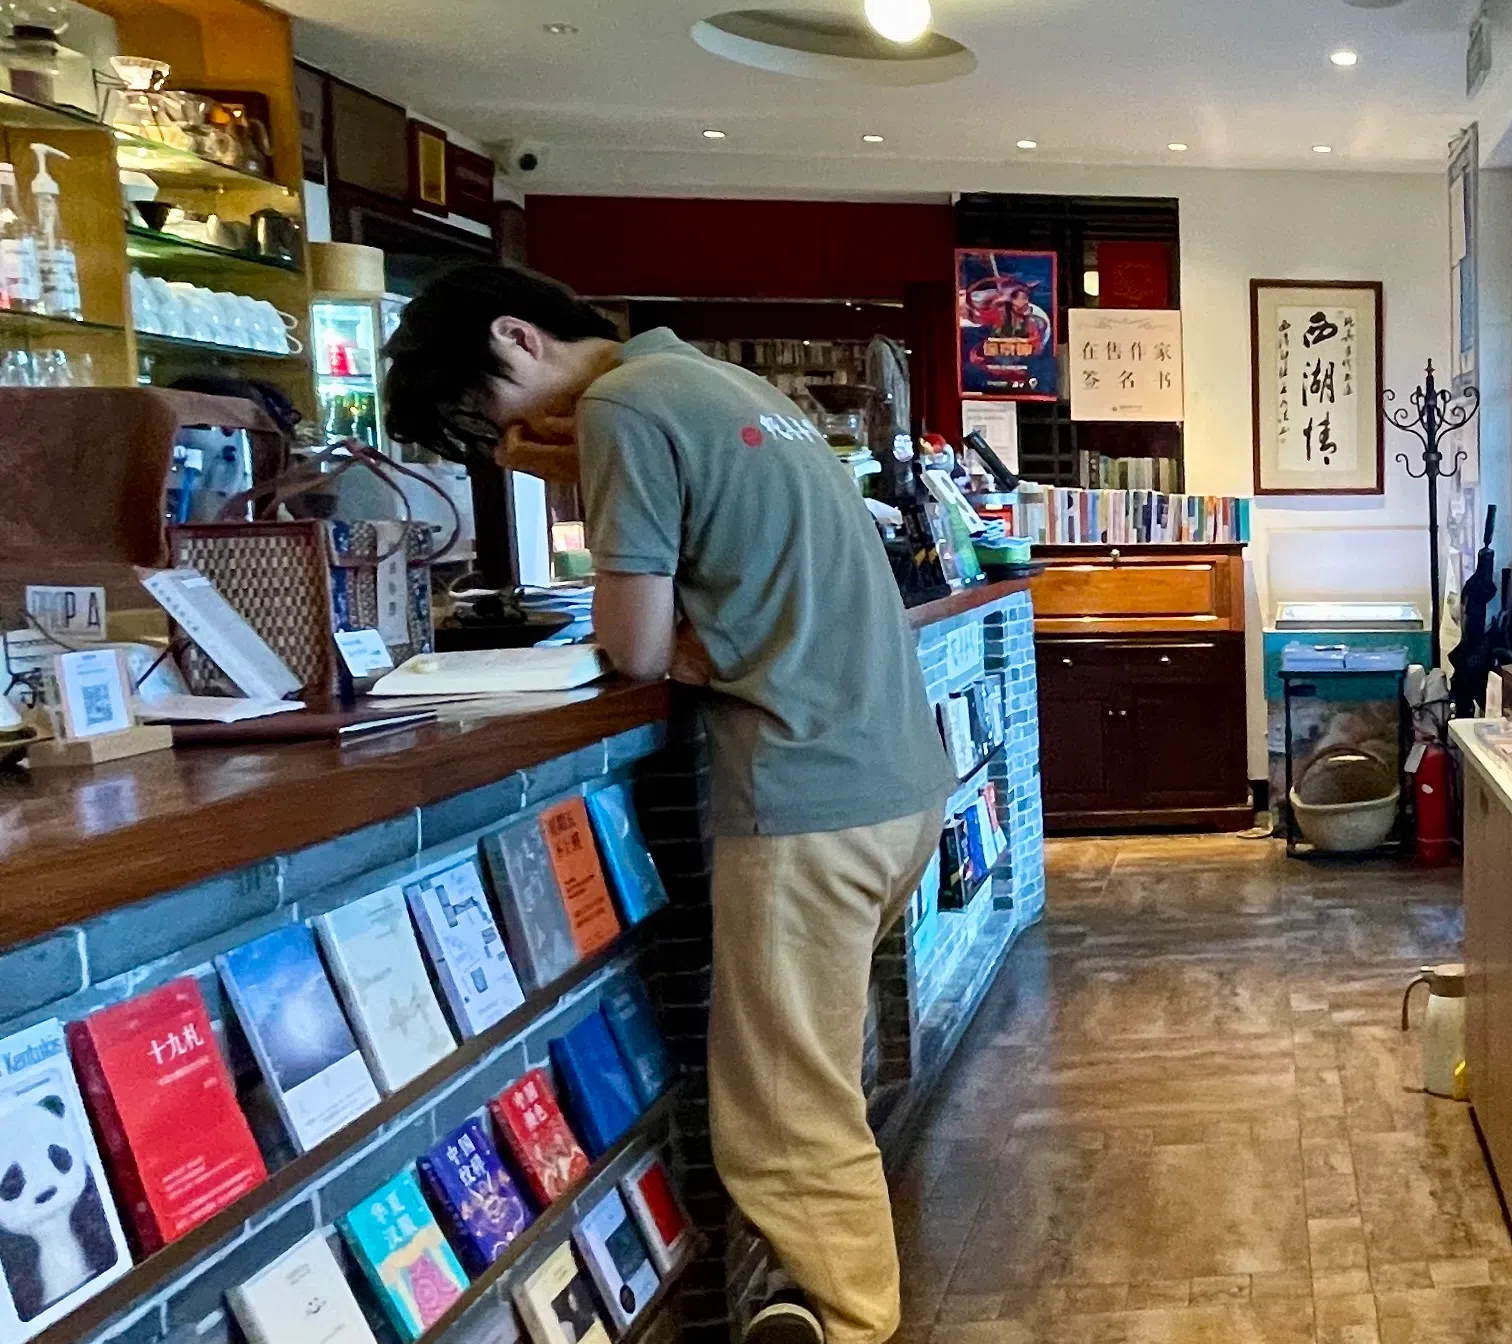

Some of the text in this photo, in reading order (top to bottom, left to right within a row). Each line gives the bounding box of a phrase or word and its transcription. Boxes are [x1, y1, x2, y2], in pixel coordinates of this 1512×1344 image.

[1082, 341, 1172, 362] 在售作家
[1082, 370, 1172, 390] 签名书
[1303, 311, 1339, 465] 西湖情
[147, 1022, 205, 1065] 十九札
